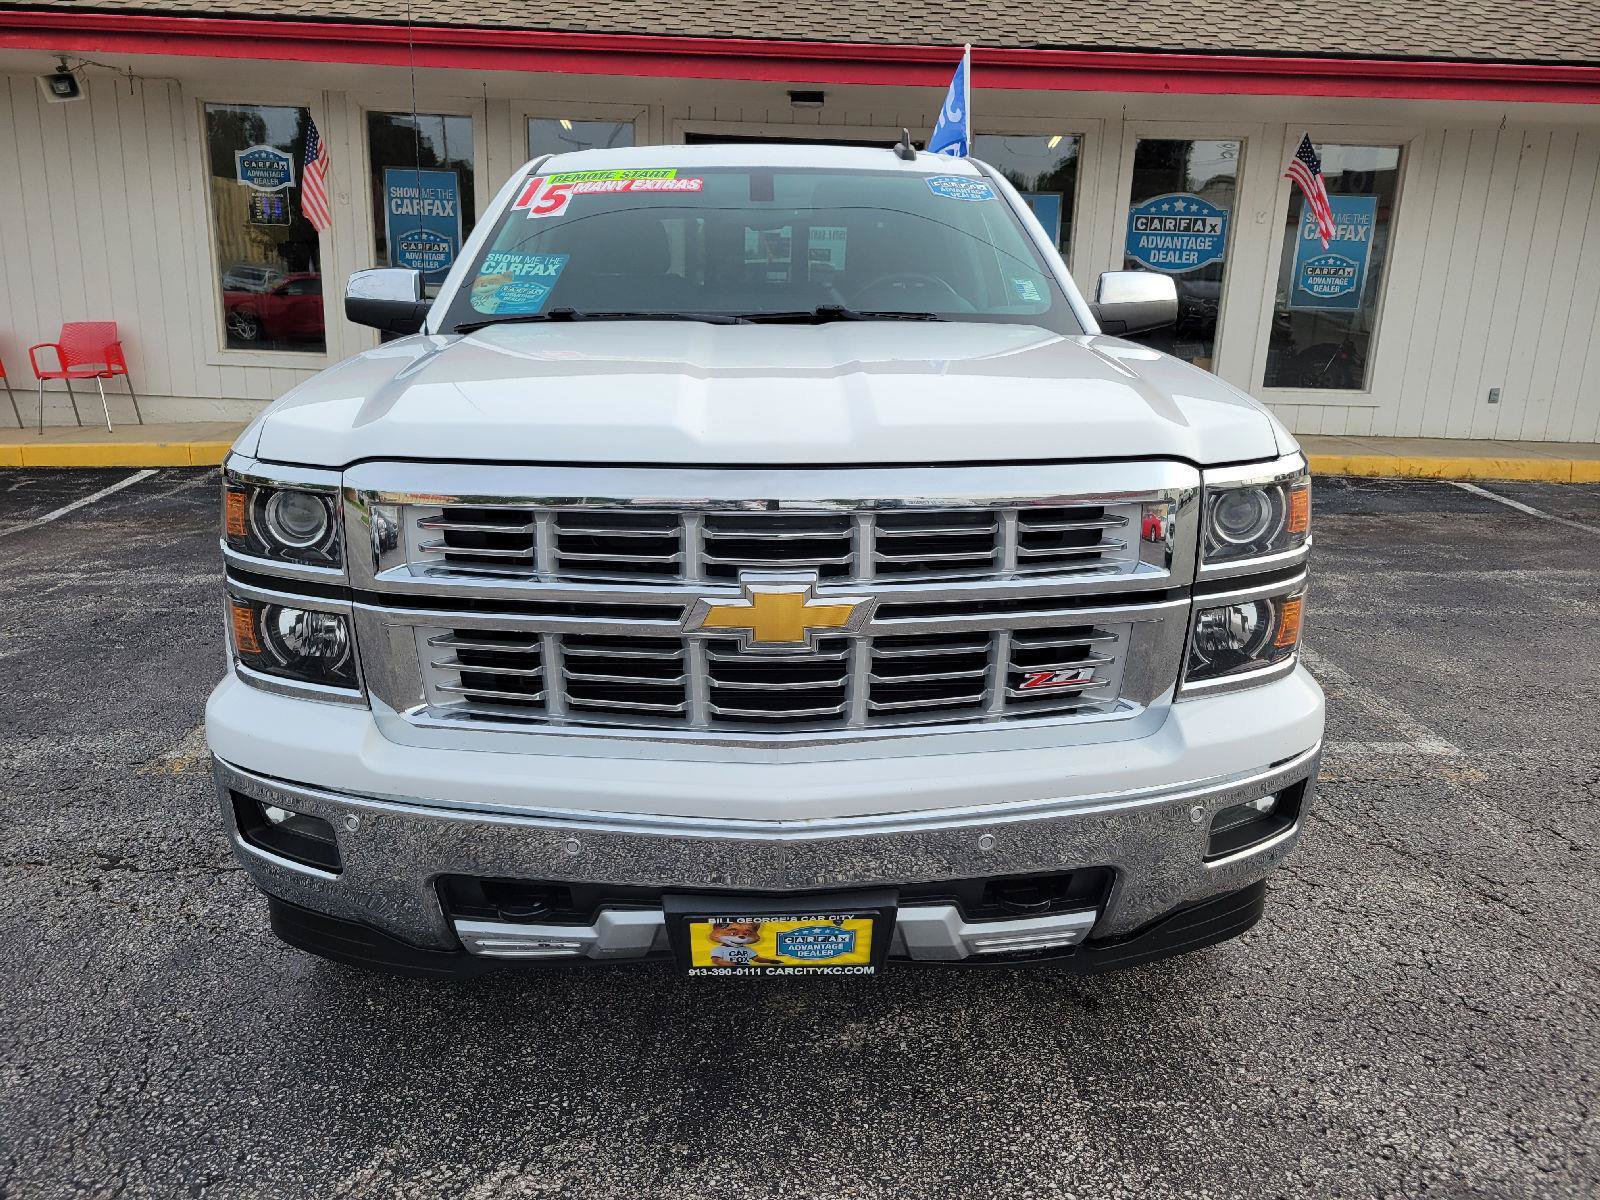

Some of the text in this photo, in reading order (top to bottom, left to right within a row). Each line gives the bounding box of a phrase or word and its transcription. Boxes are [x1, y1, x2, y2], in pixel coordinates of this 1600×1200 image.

[243, 160, 288, 170] CARFAX
[247, 170, 285, 178] ADVANTAGE
[552, 170, 672, 184] REMOTE START
[573, 179, 702, 193] MANY EXTRAS
[390, 186, 453, 200] SHOW ME THE
[516, 178, 573, 214] 15
[391, 199, 455, 217] CARFAX
[1337, 213, 1351, 224] ME
[1353, 213, 1370, 225] THE
[1136, 217, 1218, 233] CARFAX
[402, 242, 449, 252] CARFAX
[1139, 235, 1213, 250] ADVANTAGE
[405, 251, 446, 261] ADVANTAGE
[486, 253, 565, 265] SHOW ME THE
[1149, 250, 1199, 264] DEALER
[412, 260, 439, 268] DEALER
[480, 260, 560, 276] CARFAX
[1307, 267, 1353, 277] CARFAX
[1308, 276, 1348, 285] ADVANTAGE
[1314, 284, 1340, 293] DEALER
[1019, 668, 1096, 689] Z71
[736, 916, 799, 924] GEORGE'S
[784, 934, 850, 943] CARFAX
[788, 943, 844, 951] ADVANTAGE
[688, 966, 875, 976] 913-390-0111 CARCITYKC.COM
